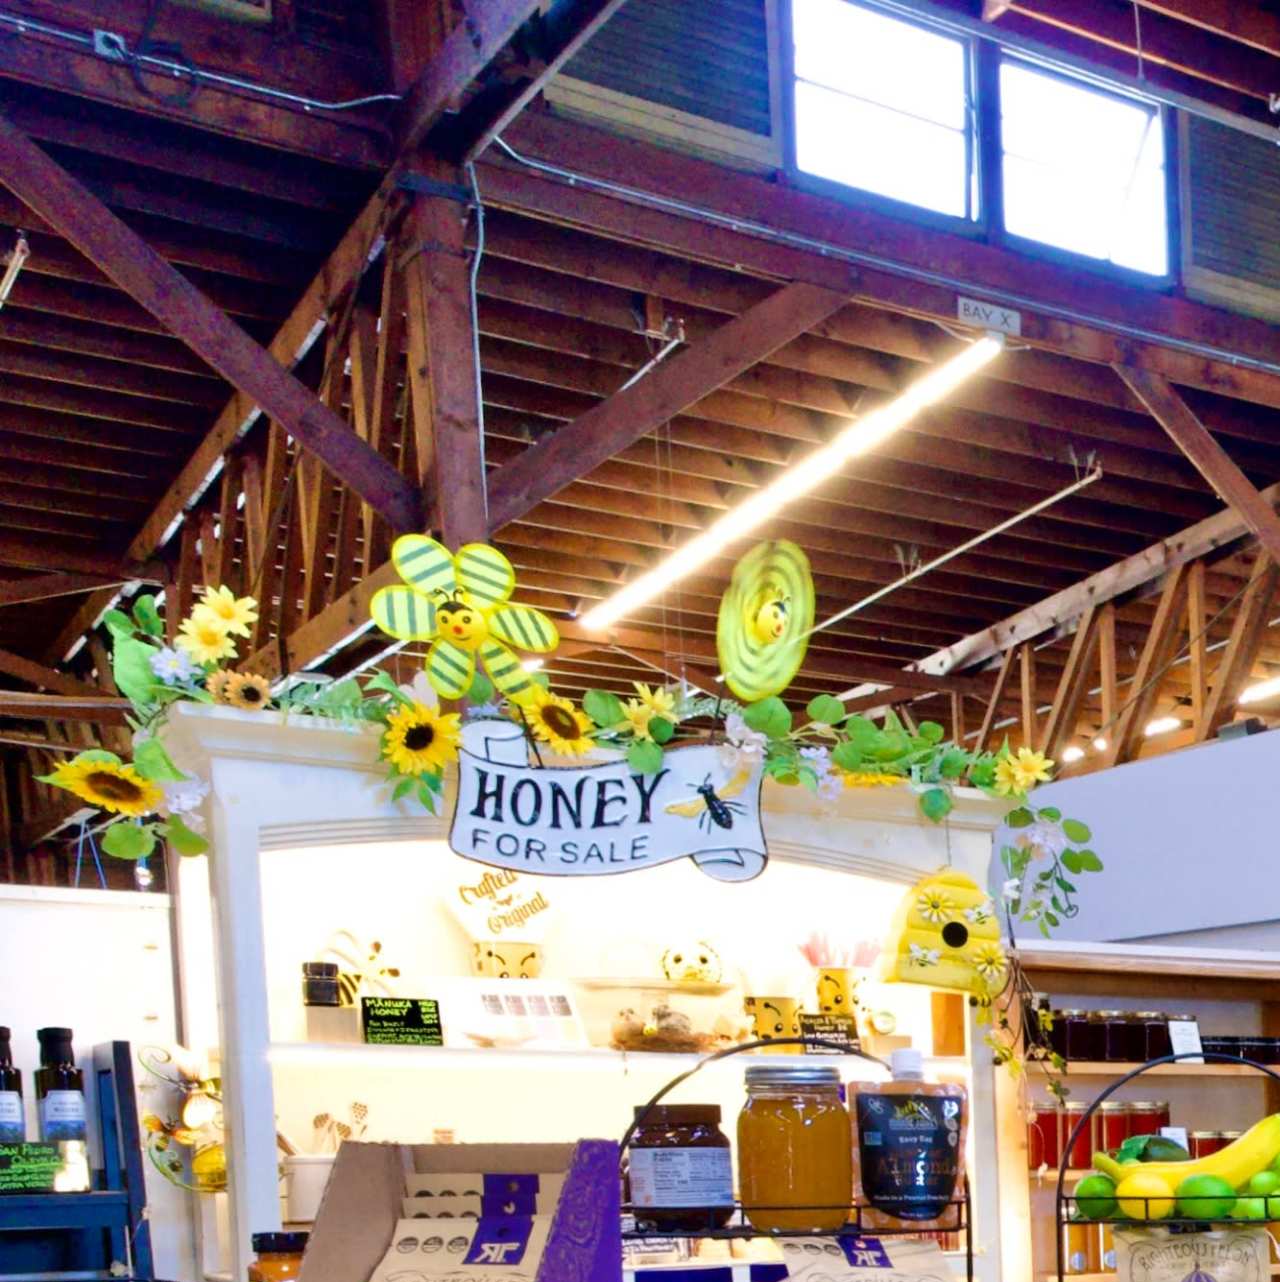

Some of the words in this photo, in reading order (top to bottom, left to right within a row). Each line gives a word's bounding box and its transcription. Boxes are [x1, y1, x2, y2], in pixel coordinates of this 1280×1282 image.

[963, 302, 992, 321] BAY
[1000, 311, 1010, 328] X
[469, 767, 671, 830] HONEY
[472, 828, 547, 861] FOR
[559, 835, 649, 864] SALE
[487, 890, 549, 935] Original
[370, 1008, 408, 1016] HONEY
